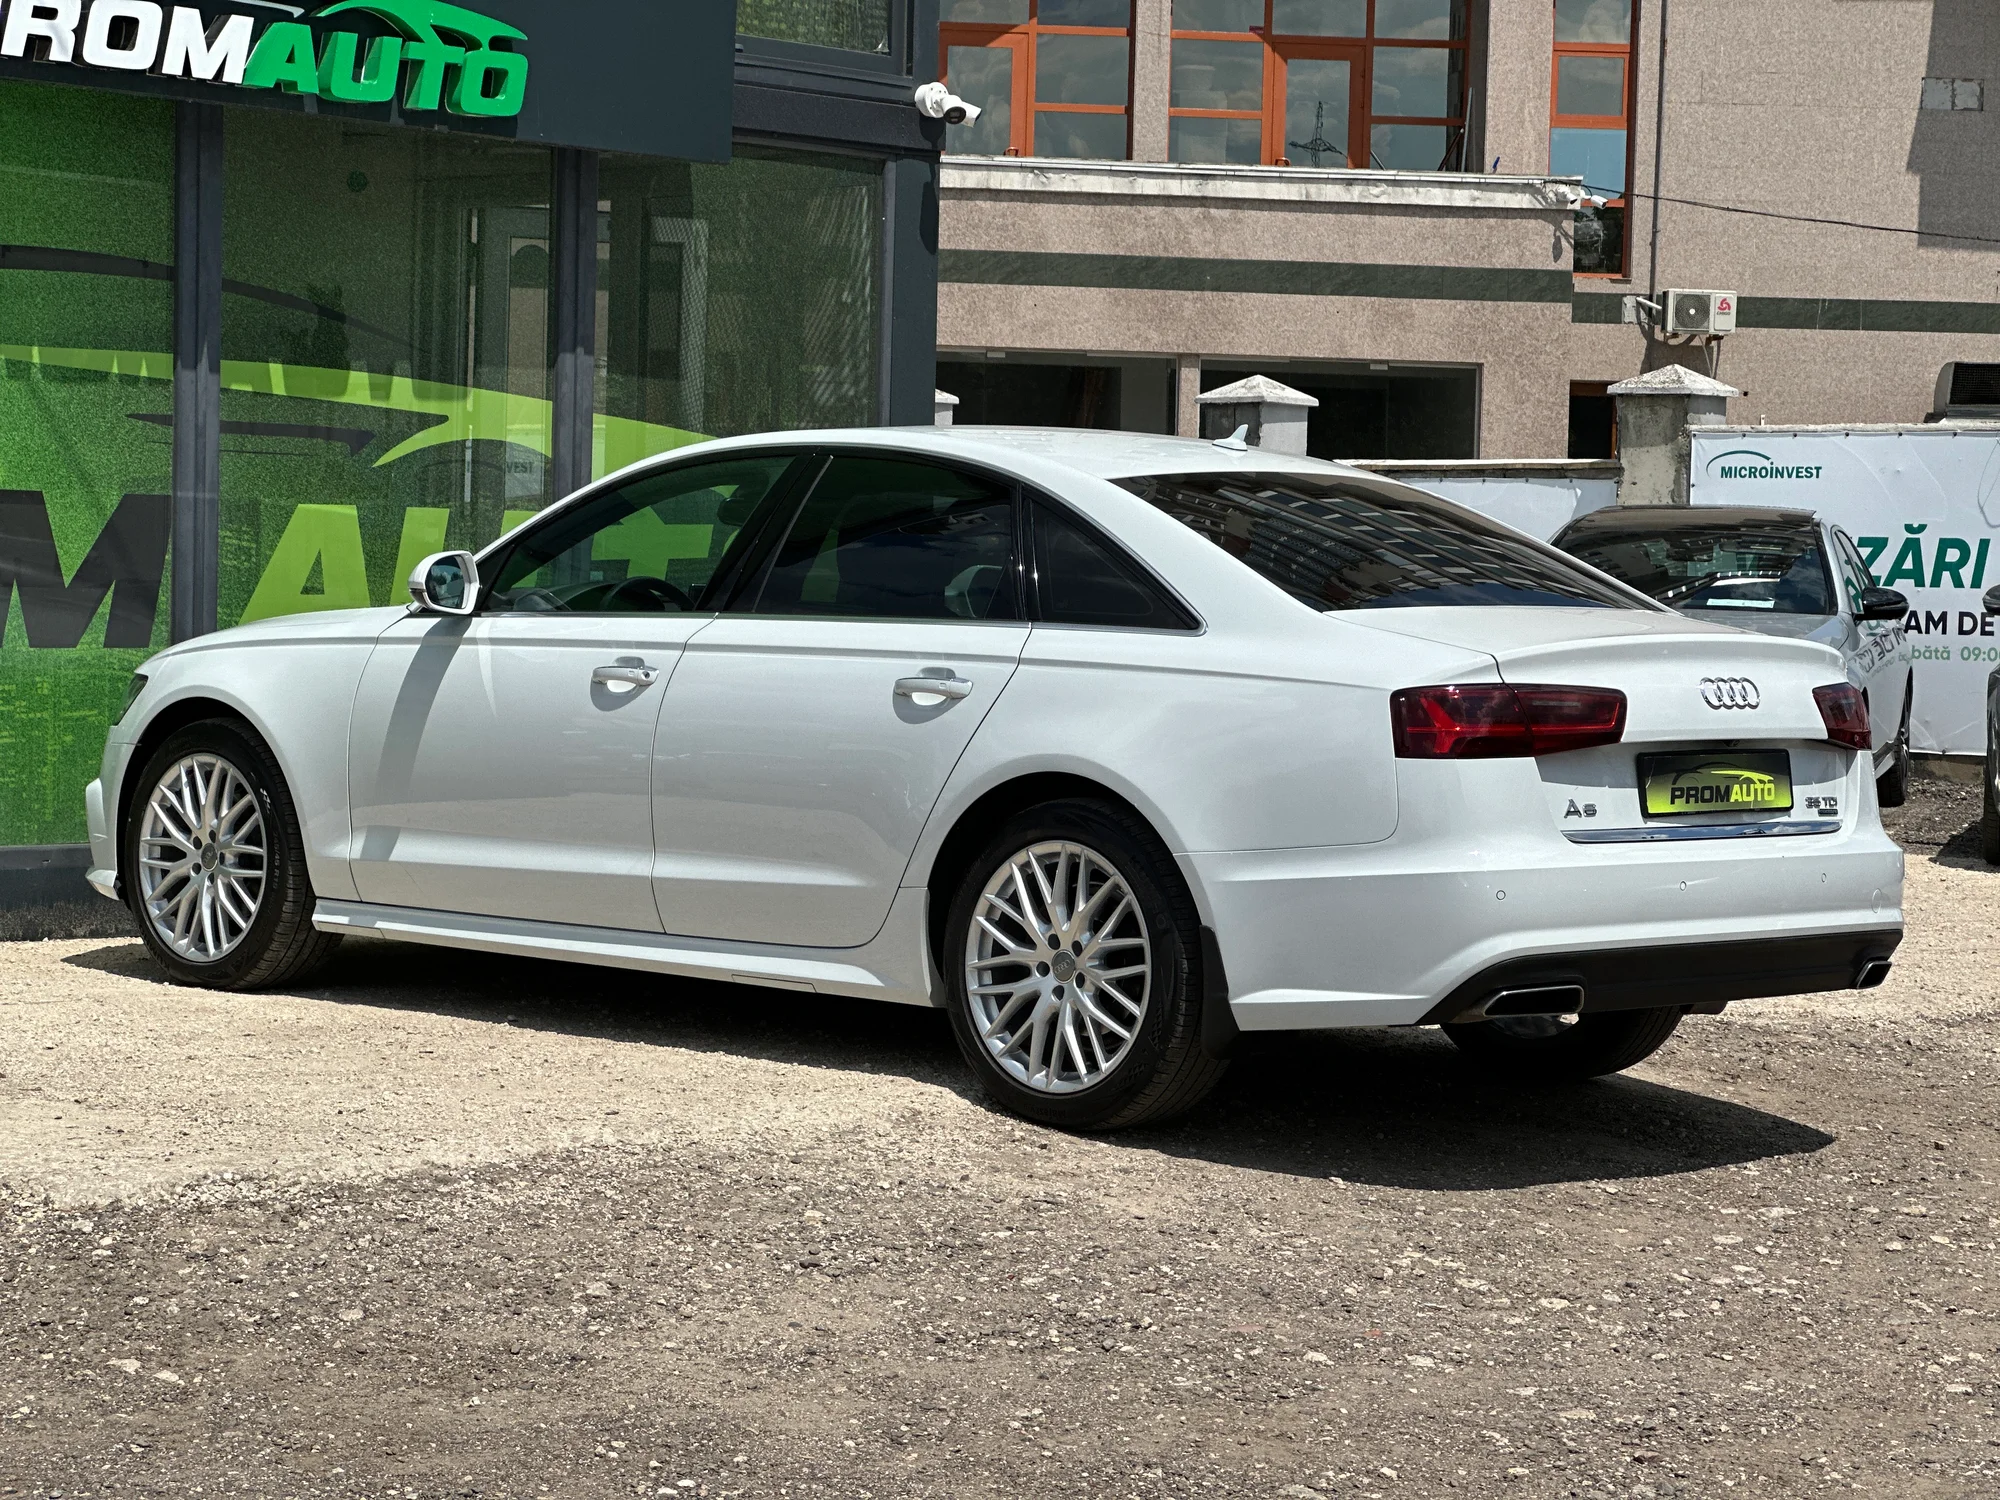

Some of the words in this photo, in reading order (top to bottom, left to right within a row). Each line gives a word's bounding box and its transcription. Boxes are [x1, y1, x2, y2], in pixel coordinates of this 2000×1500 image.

[0, 0, 528, 117] ROMAUTO
[1857, 523, 1991, 589] ZĂRI
[1904, 610, 1948, 635] AM
[1958, 611, 1995, 636] DE
[1912, 645, 1951, 661] bătă
[1961, 646, 2000, 662] 09:0
[1670, 783, 1775, 805] PROMAUTO
